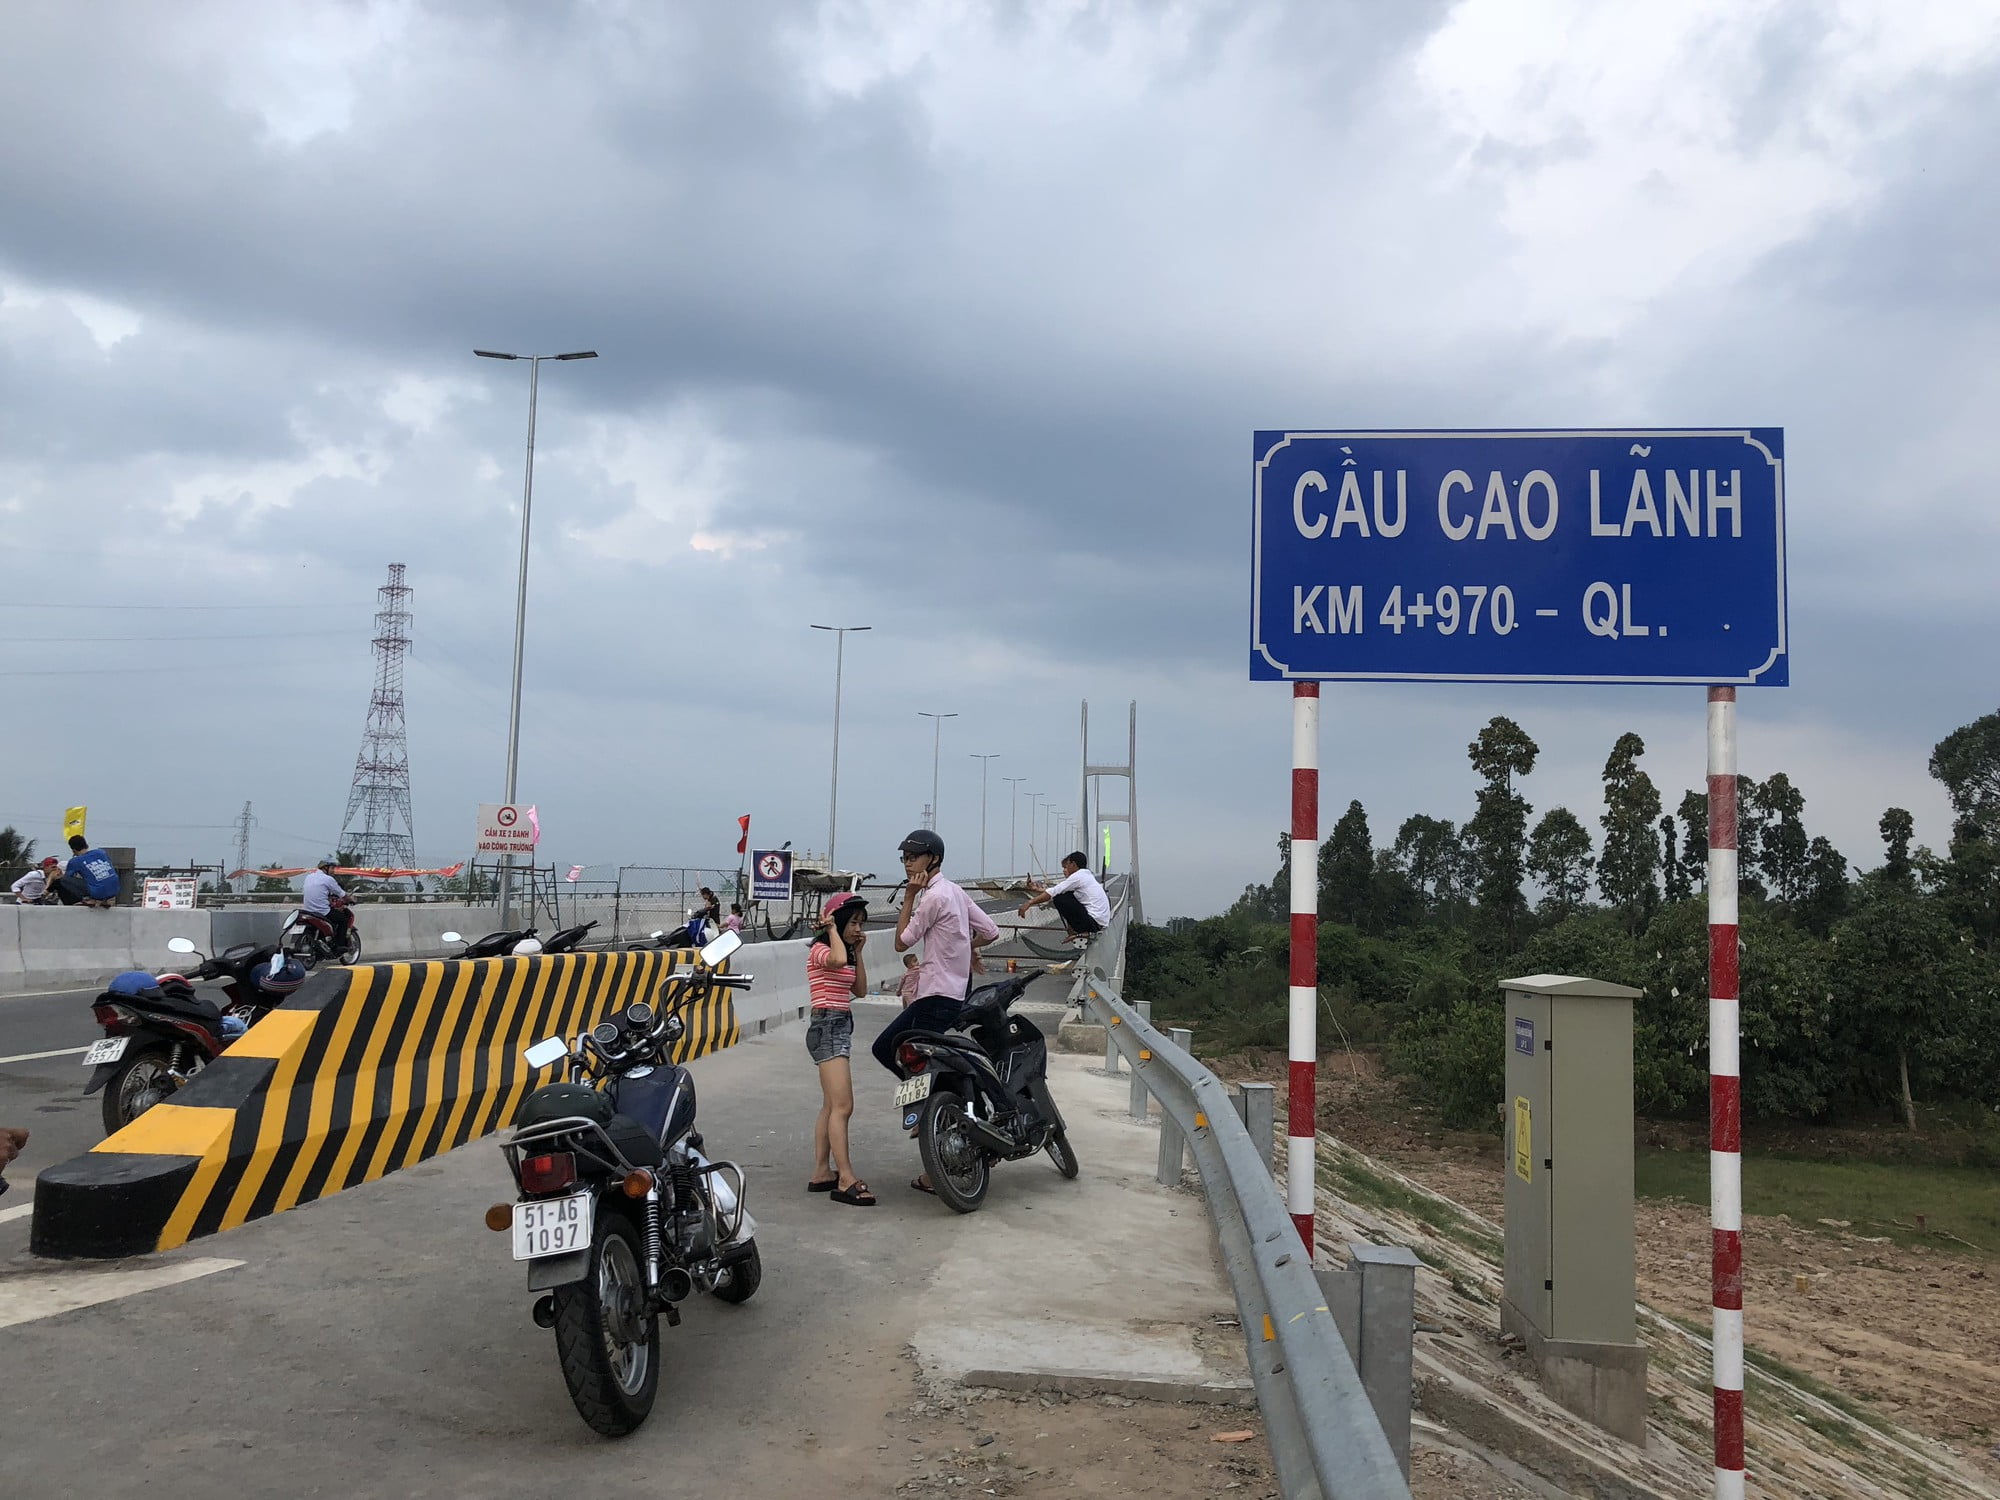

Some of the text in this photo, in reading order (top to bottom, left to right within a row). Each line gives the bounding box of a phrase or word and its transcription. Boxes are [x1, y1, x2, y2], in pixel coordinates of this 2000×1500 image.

[1292, 443, 1743, 541] CẦU CAO LÃNH
[1292, 584, 1364, 635] KM
[1379, 584, 1516, 636] 4+970
[1582, 581, 1669, 640] QL.
[498, 829, 507, 838] XE
[524, 1199, 578, 1229] 51-A6
[527, 1223, 578, 1254] 1097
